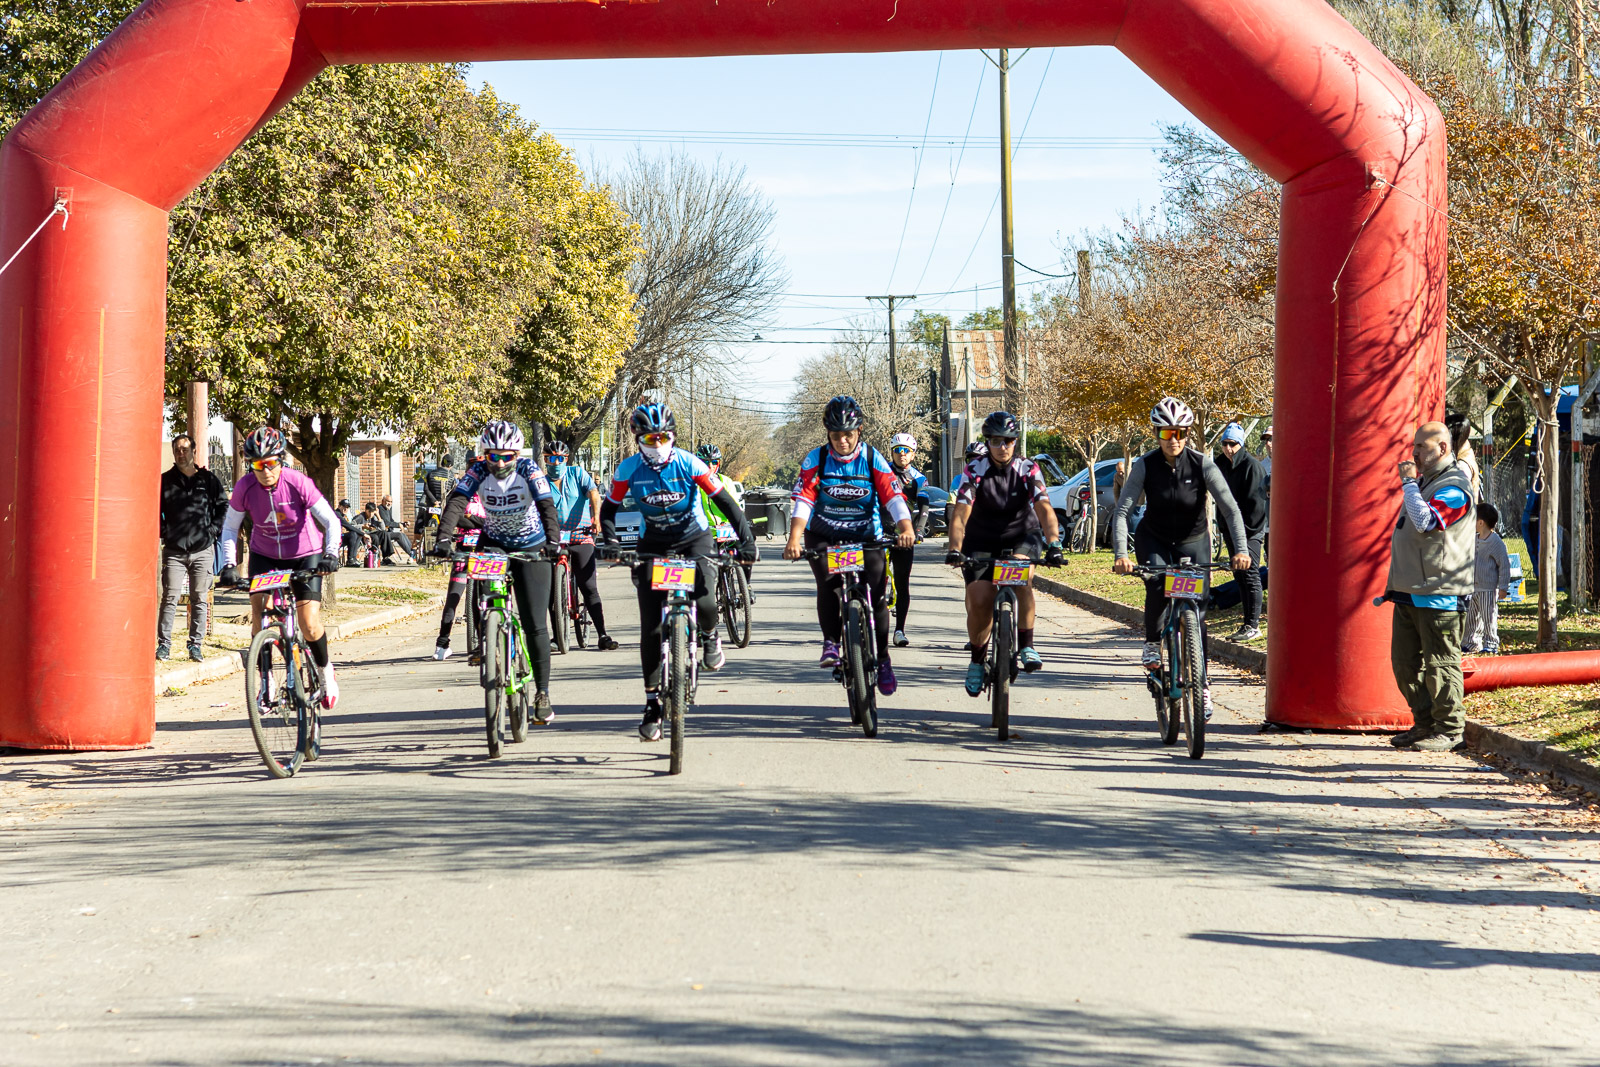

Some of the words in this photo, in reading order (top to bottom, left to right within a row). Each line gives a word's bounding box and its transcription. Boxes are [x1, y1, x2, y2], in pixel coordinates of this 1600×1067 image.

[835, 552, 857, 566] 46
[472, 560, 503, 573] 150
[663, 568, 684, 583] 15
[999, 567, 1025, 580] 115
[256, 574, 284, 587] 139
[1171, 577, 1198, 593] 86
